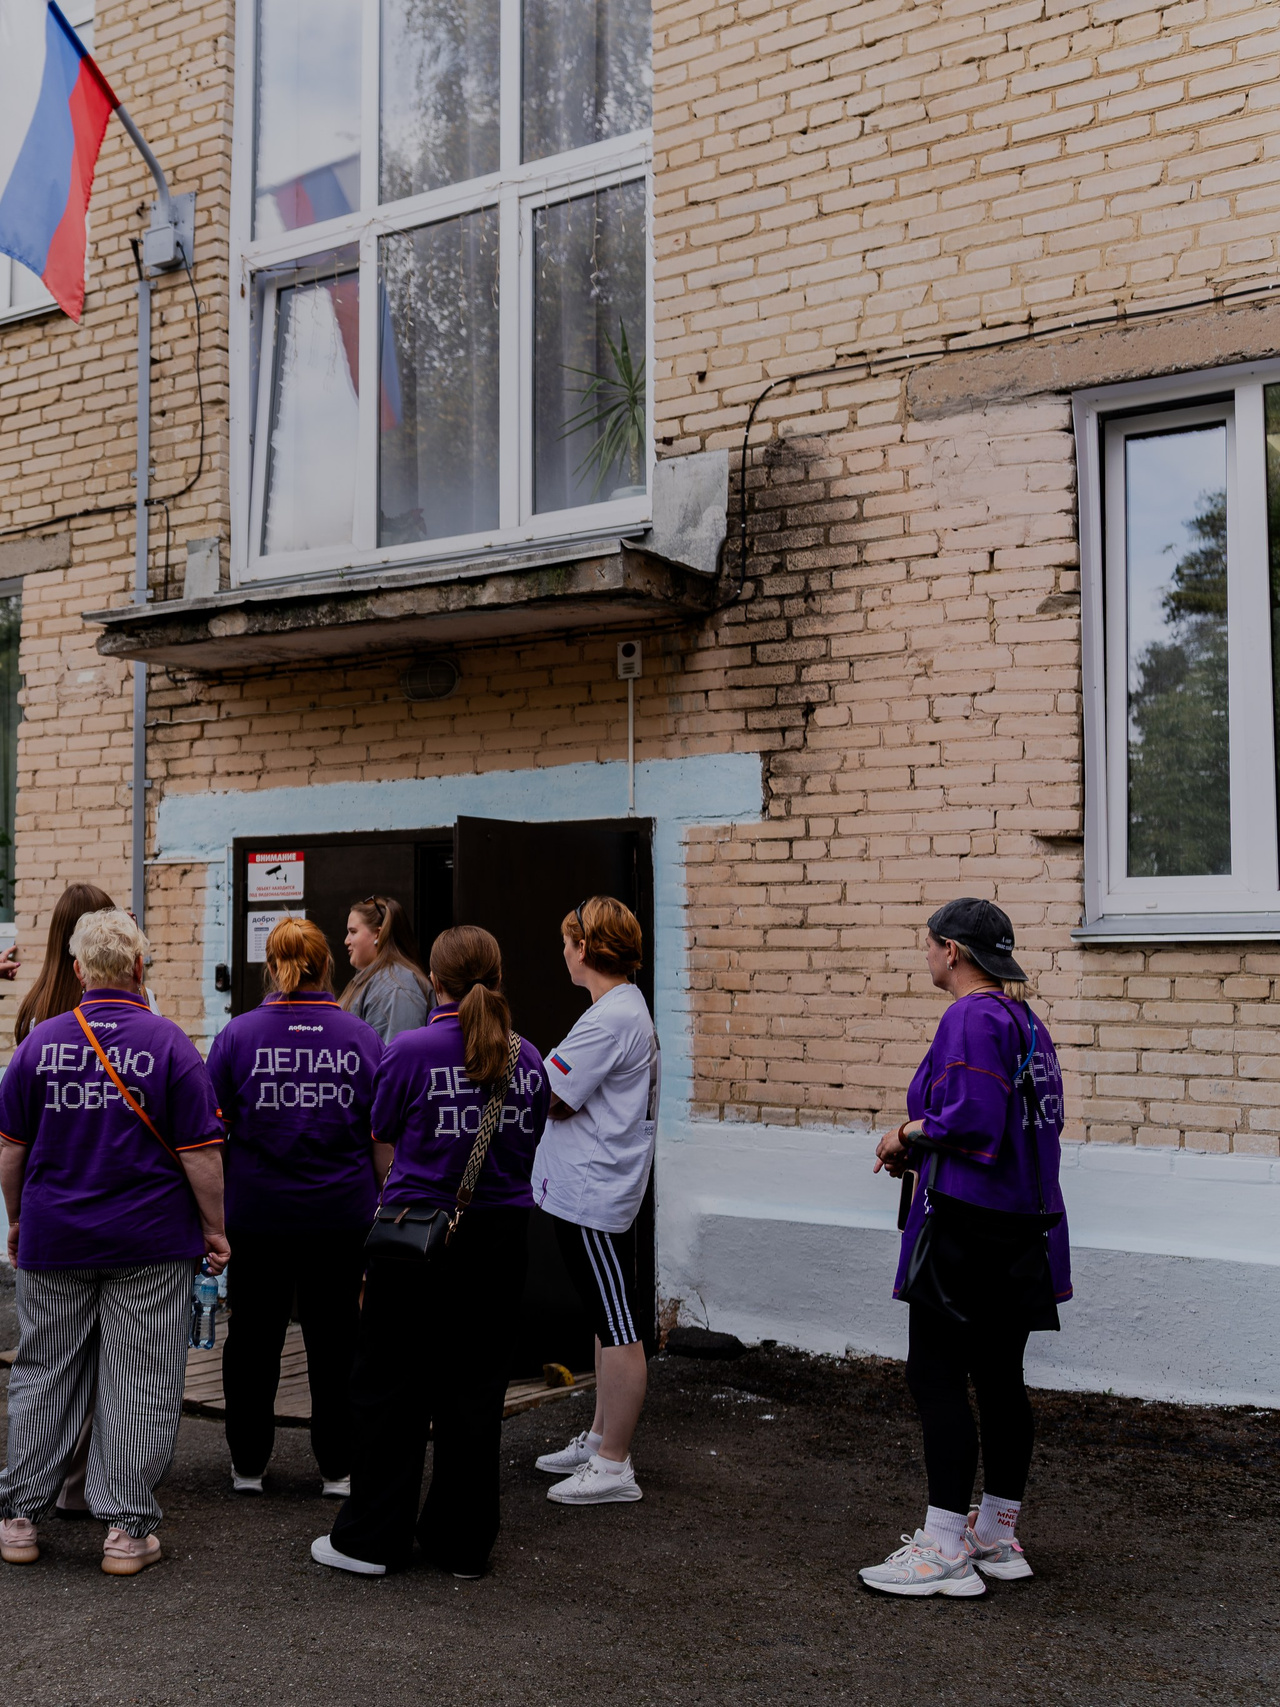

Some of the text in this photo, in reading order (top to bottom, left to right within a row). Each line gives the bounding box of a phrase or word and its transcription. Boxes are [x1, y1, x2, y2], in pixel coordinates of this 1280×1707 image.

[255, 853, 297, 862] ВНИМАНИЕ
[87, 1021, 117, 1029] обро.рф
[288, 1024, 324, 1033] добро.рф
[251, 1048, 360, 1077] ДЕЛАЮ
[256, 1082, 355, 1110] ДОБРО
[434, 1105, 535, 1138] ДОРО
